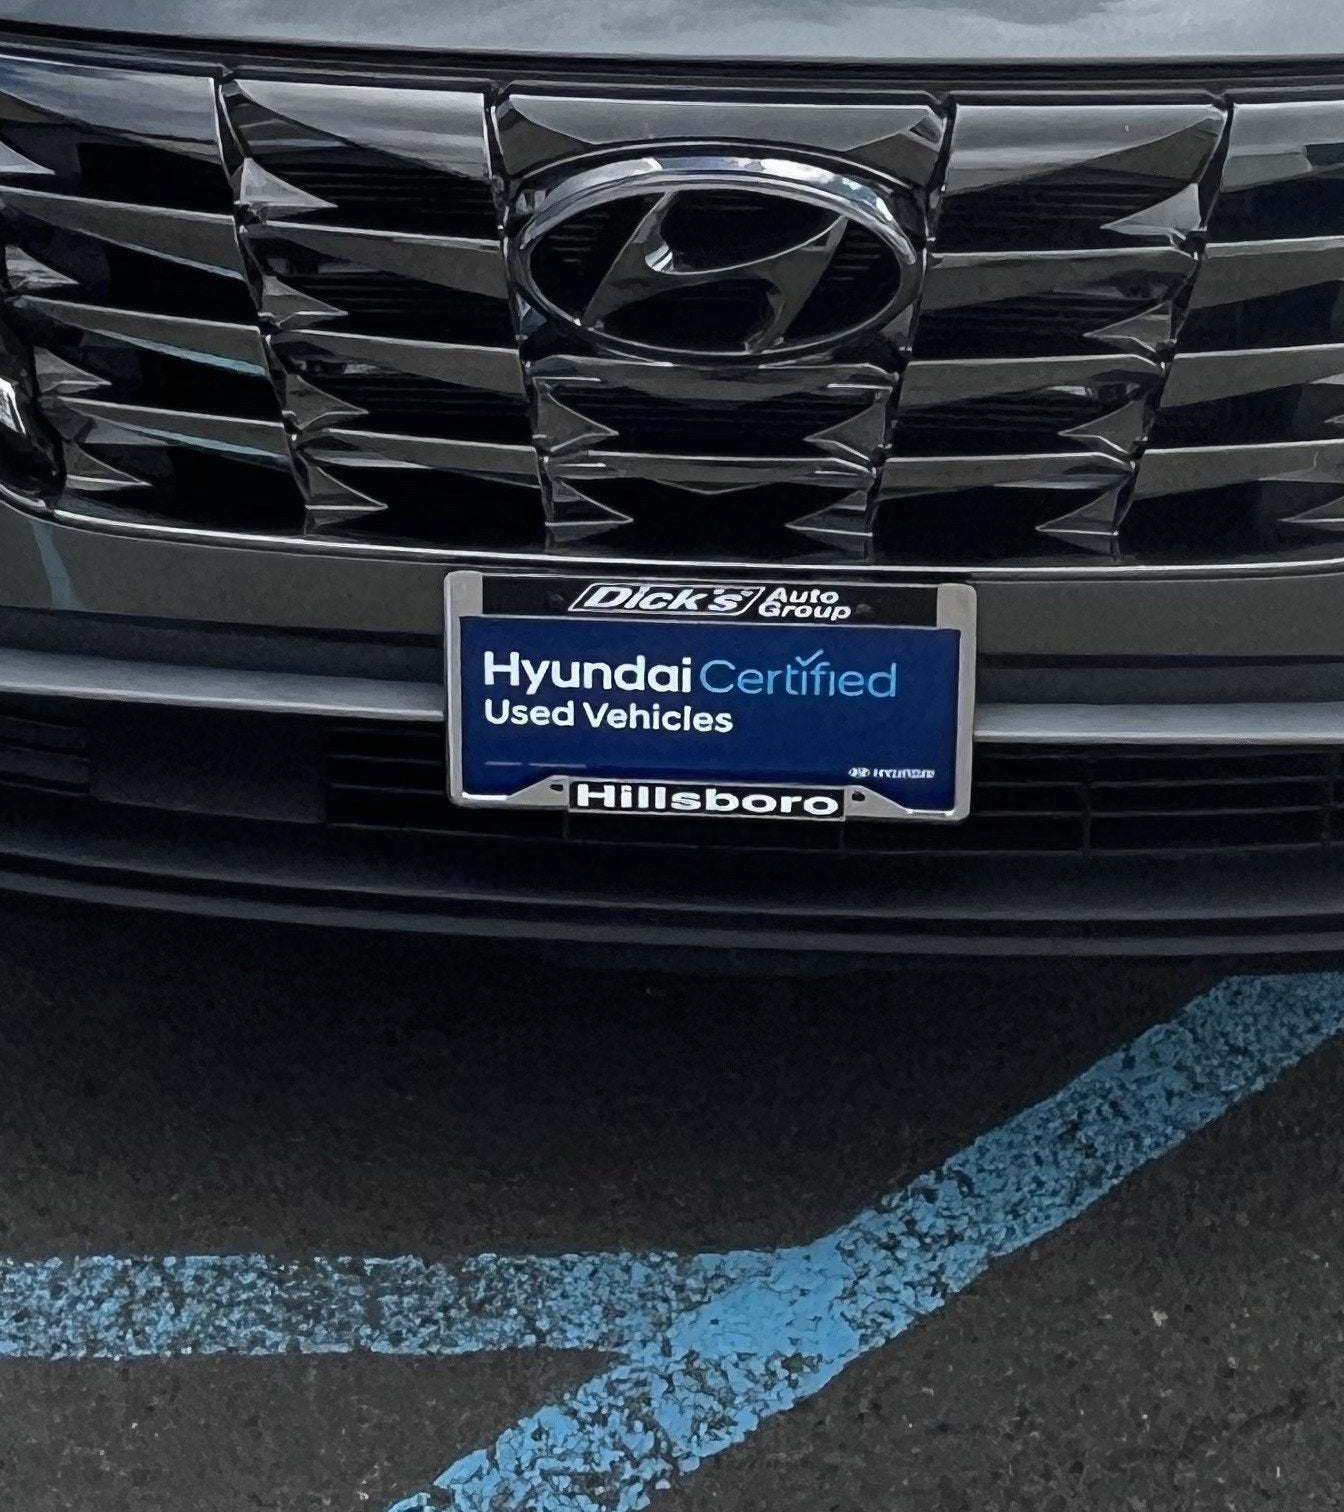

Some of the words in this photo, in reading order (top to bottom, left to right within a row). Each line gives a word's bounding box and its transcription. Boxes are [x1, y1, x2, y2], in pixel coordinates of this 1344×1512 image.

[757, 601, 852, 621] Group
[764, 587, 840, 604] Auto
[484, 650, 692, 695] Hyundai
[699, 649, 897, 698] Certified
[484, 699, 575, 727] Used
[582, 701, 734, 733] Vehicles
[576, 783, 840, 816] Hillsboro
